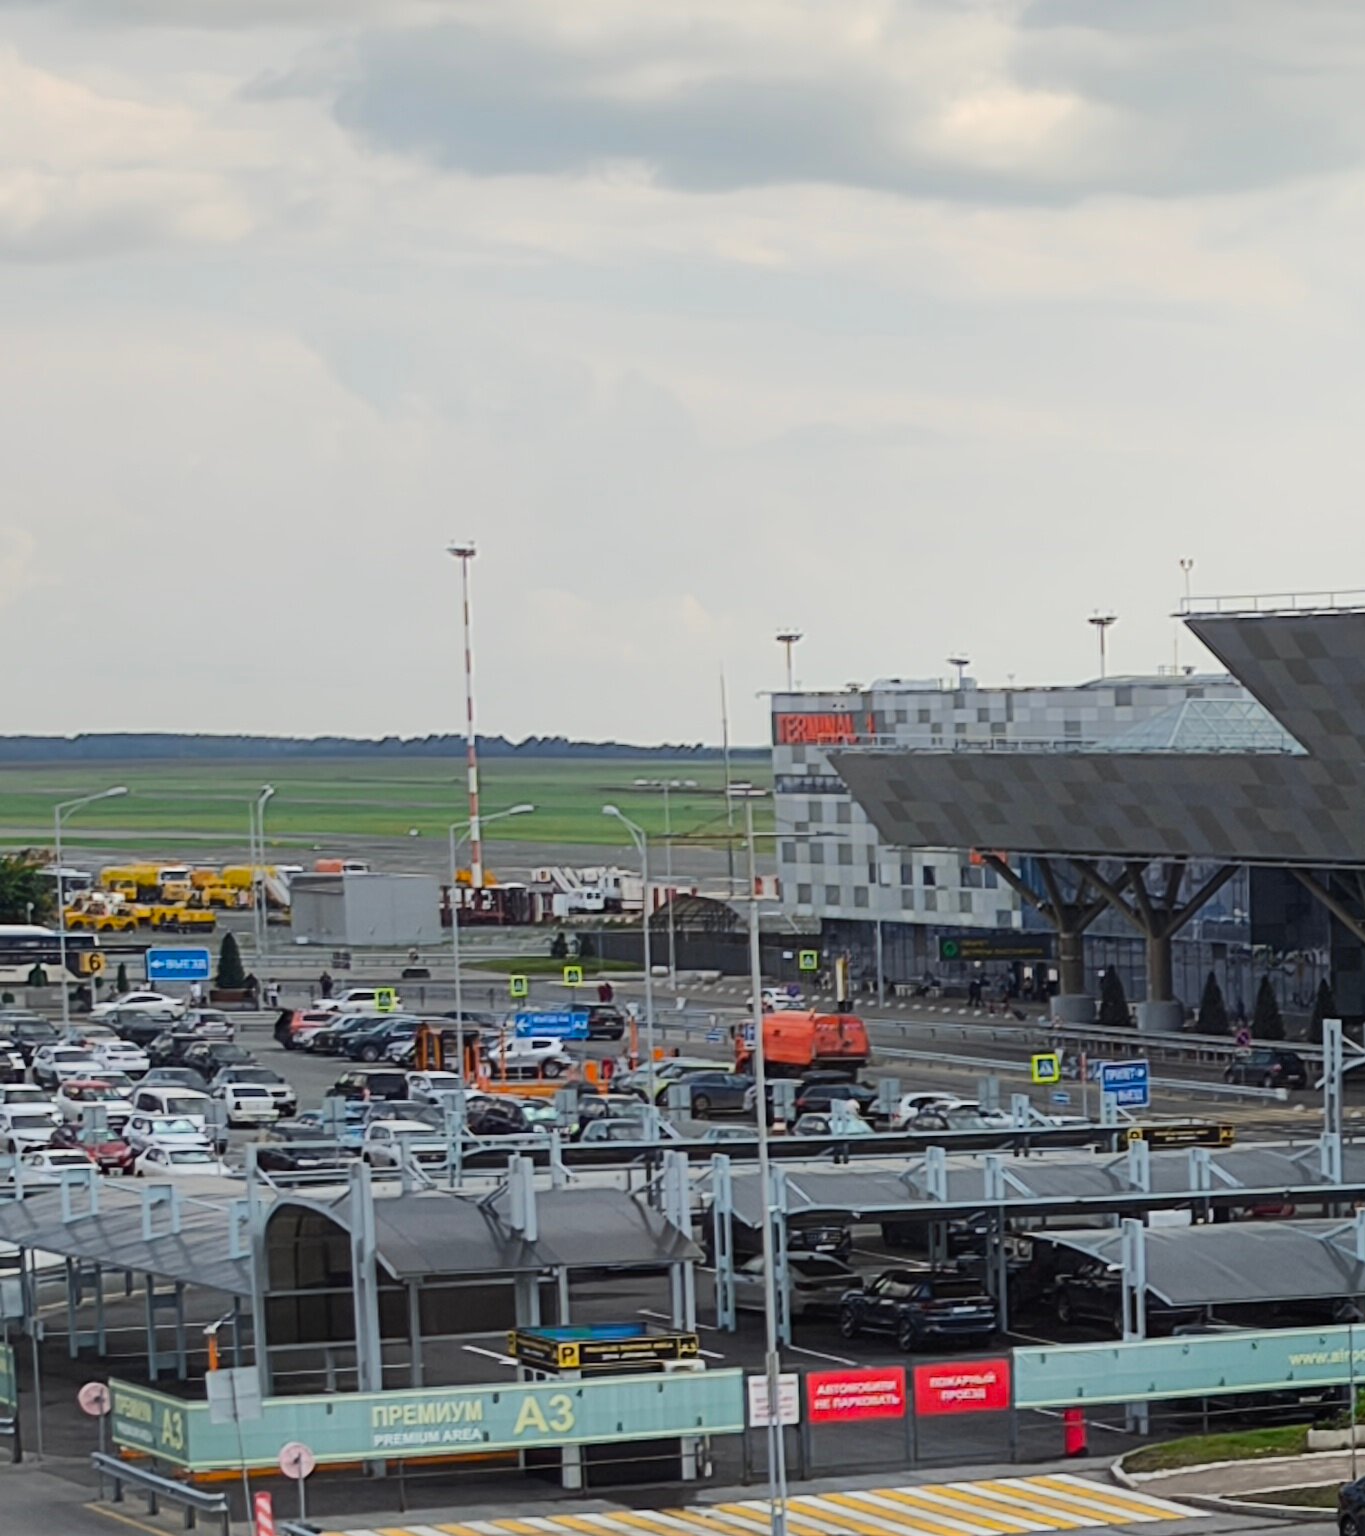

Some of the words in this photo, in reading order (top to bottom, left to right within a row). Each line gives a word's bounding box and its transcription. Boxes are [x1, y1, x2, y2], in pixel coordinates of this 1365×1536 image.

[88, 953, 101, 972] 6
[371, 1398, 483, 1429] ПРЕМИУМ
[513, 1394, 576, 1436] А3
[374, 1431, 441, 1448] PREMIUM
[442, 1428, 482, 1444] AREA
